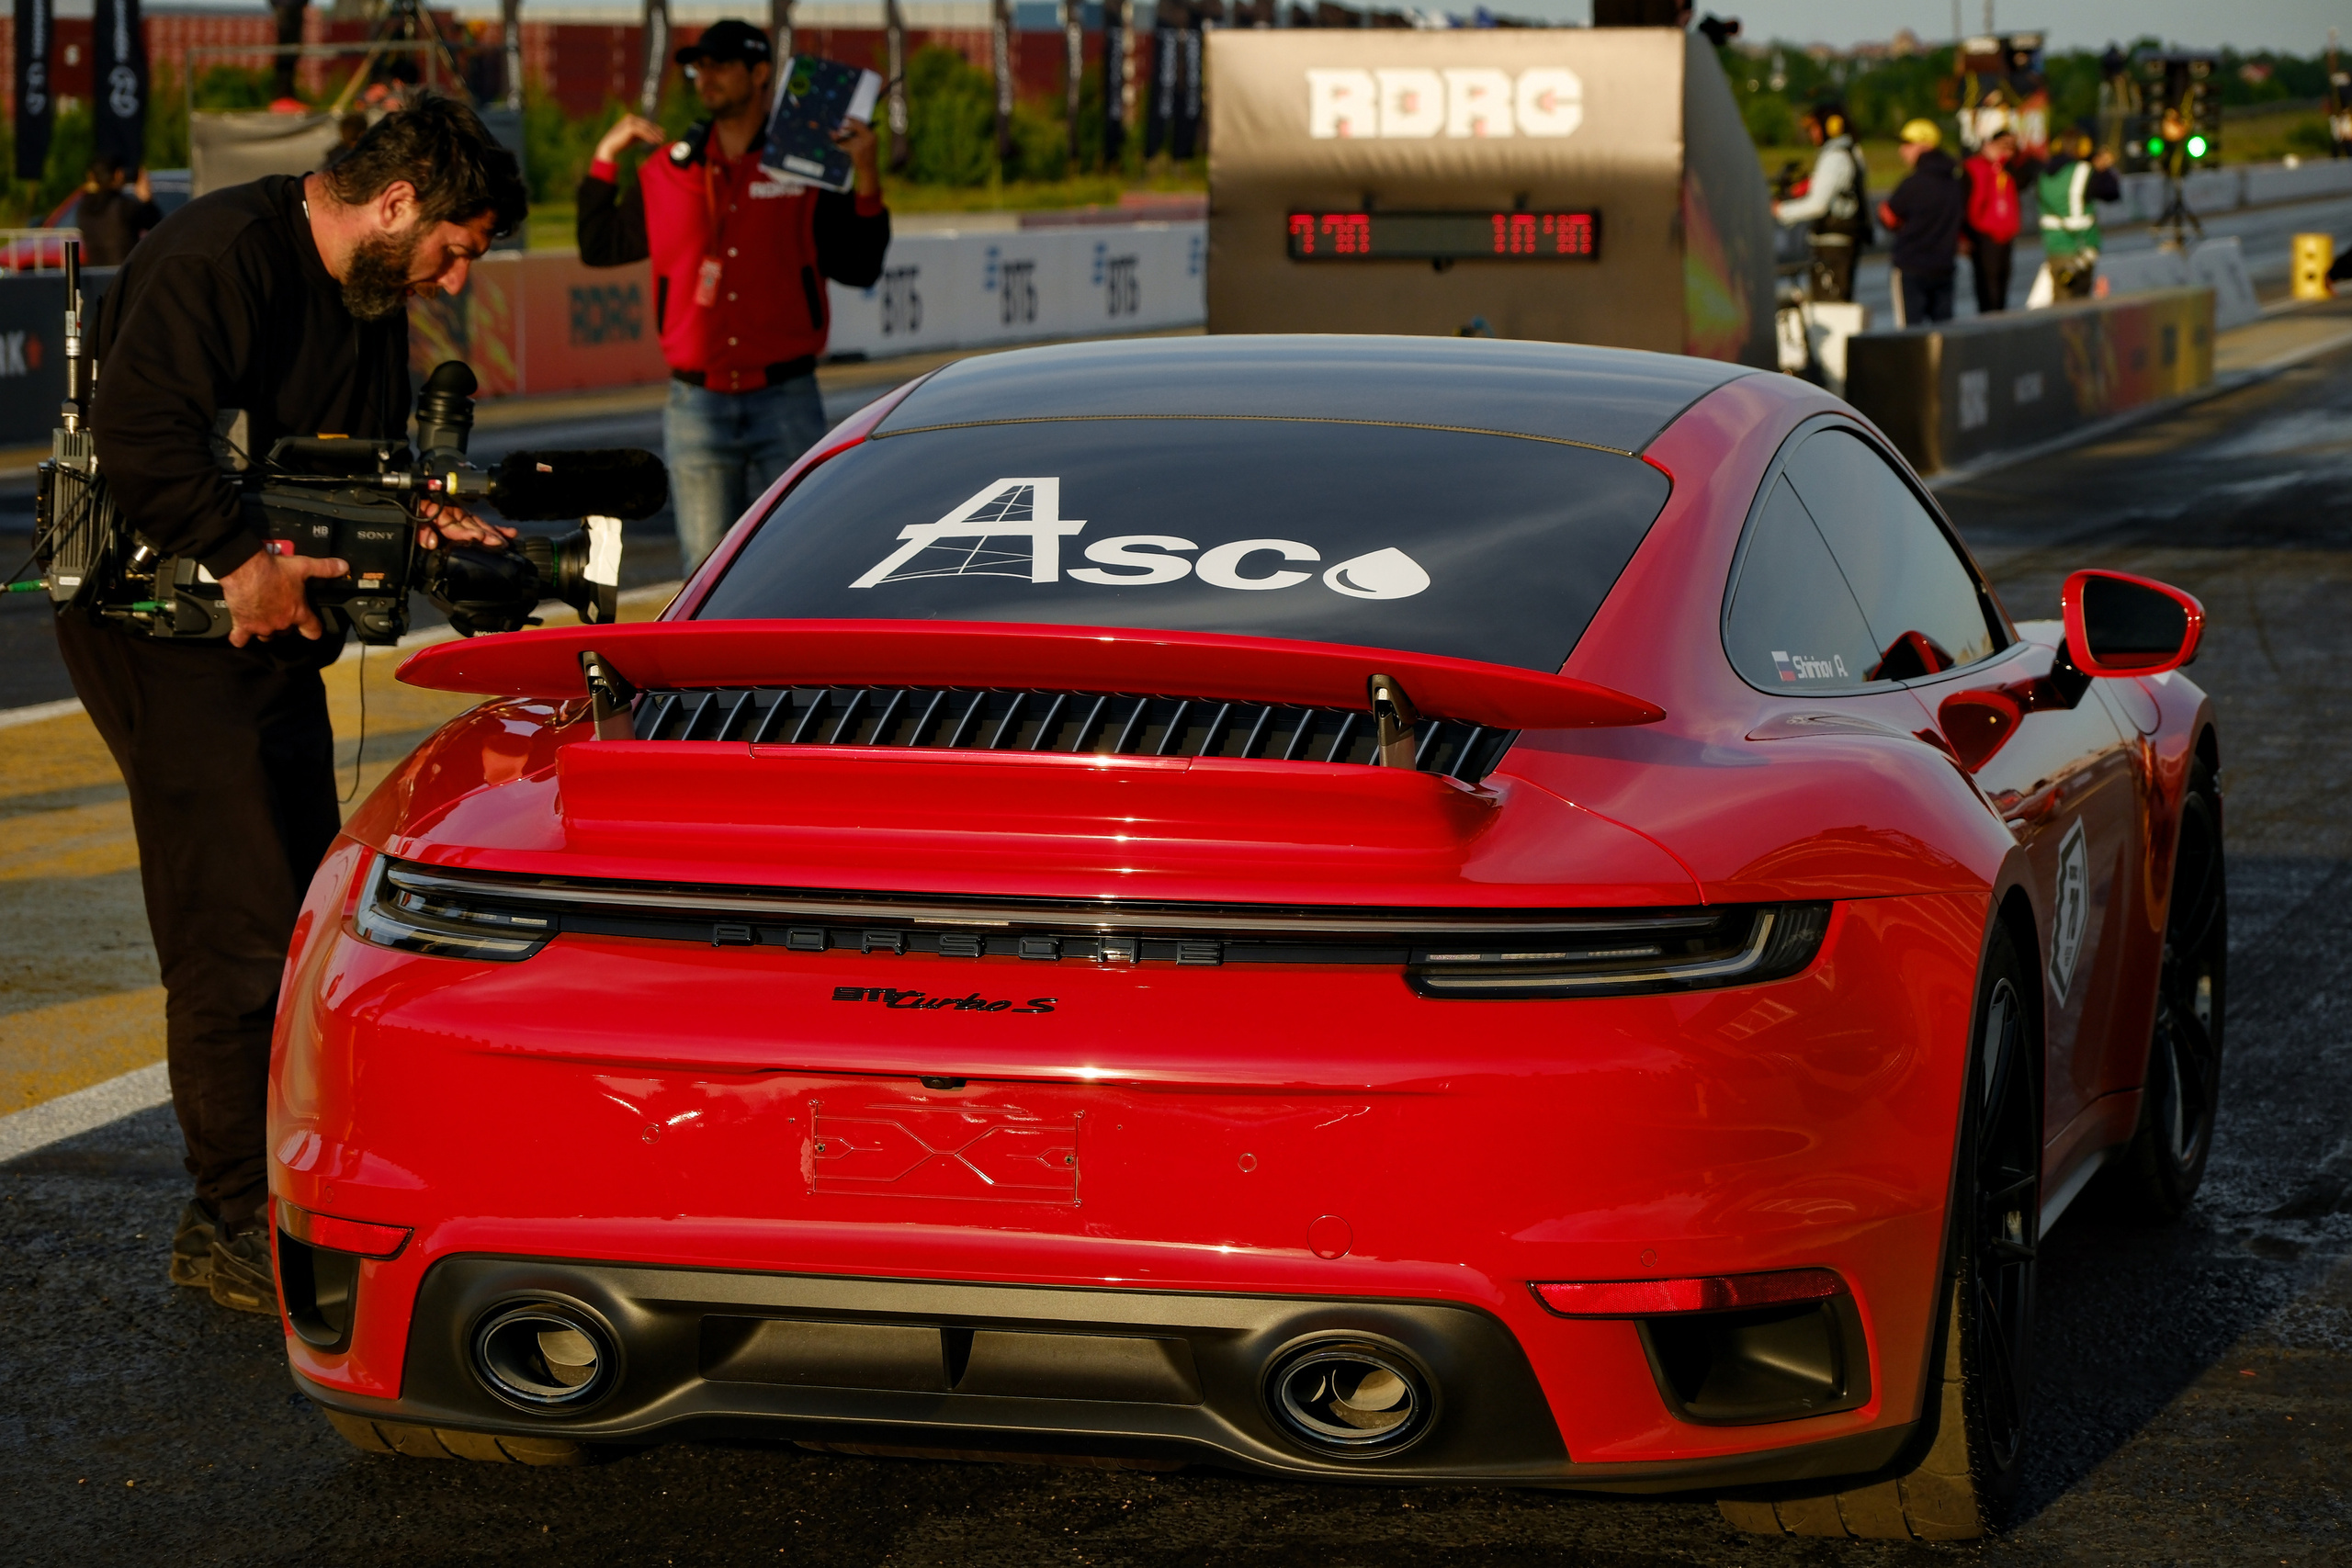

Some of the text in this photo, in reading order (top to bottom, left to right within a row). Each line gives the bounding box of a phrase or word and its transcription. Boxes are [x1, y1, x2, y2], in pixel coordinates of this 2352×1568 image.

[1306, 67, 1583, 139] RDRC
[356, 530, 394, 540] SONY
[712, 924, 1224, 965] PORSCHE
[831, 987, 1058, 1013] 911 turbo S
